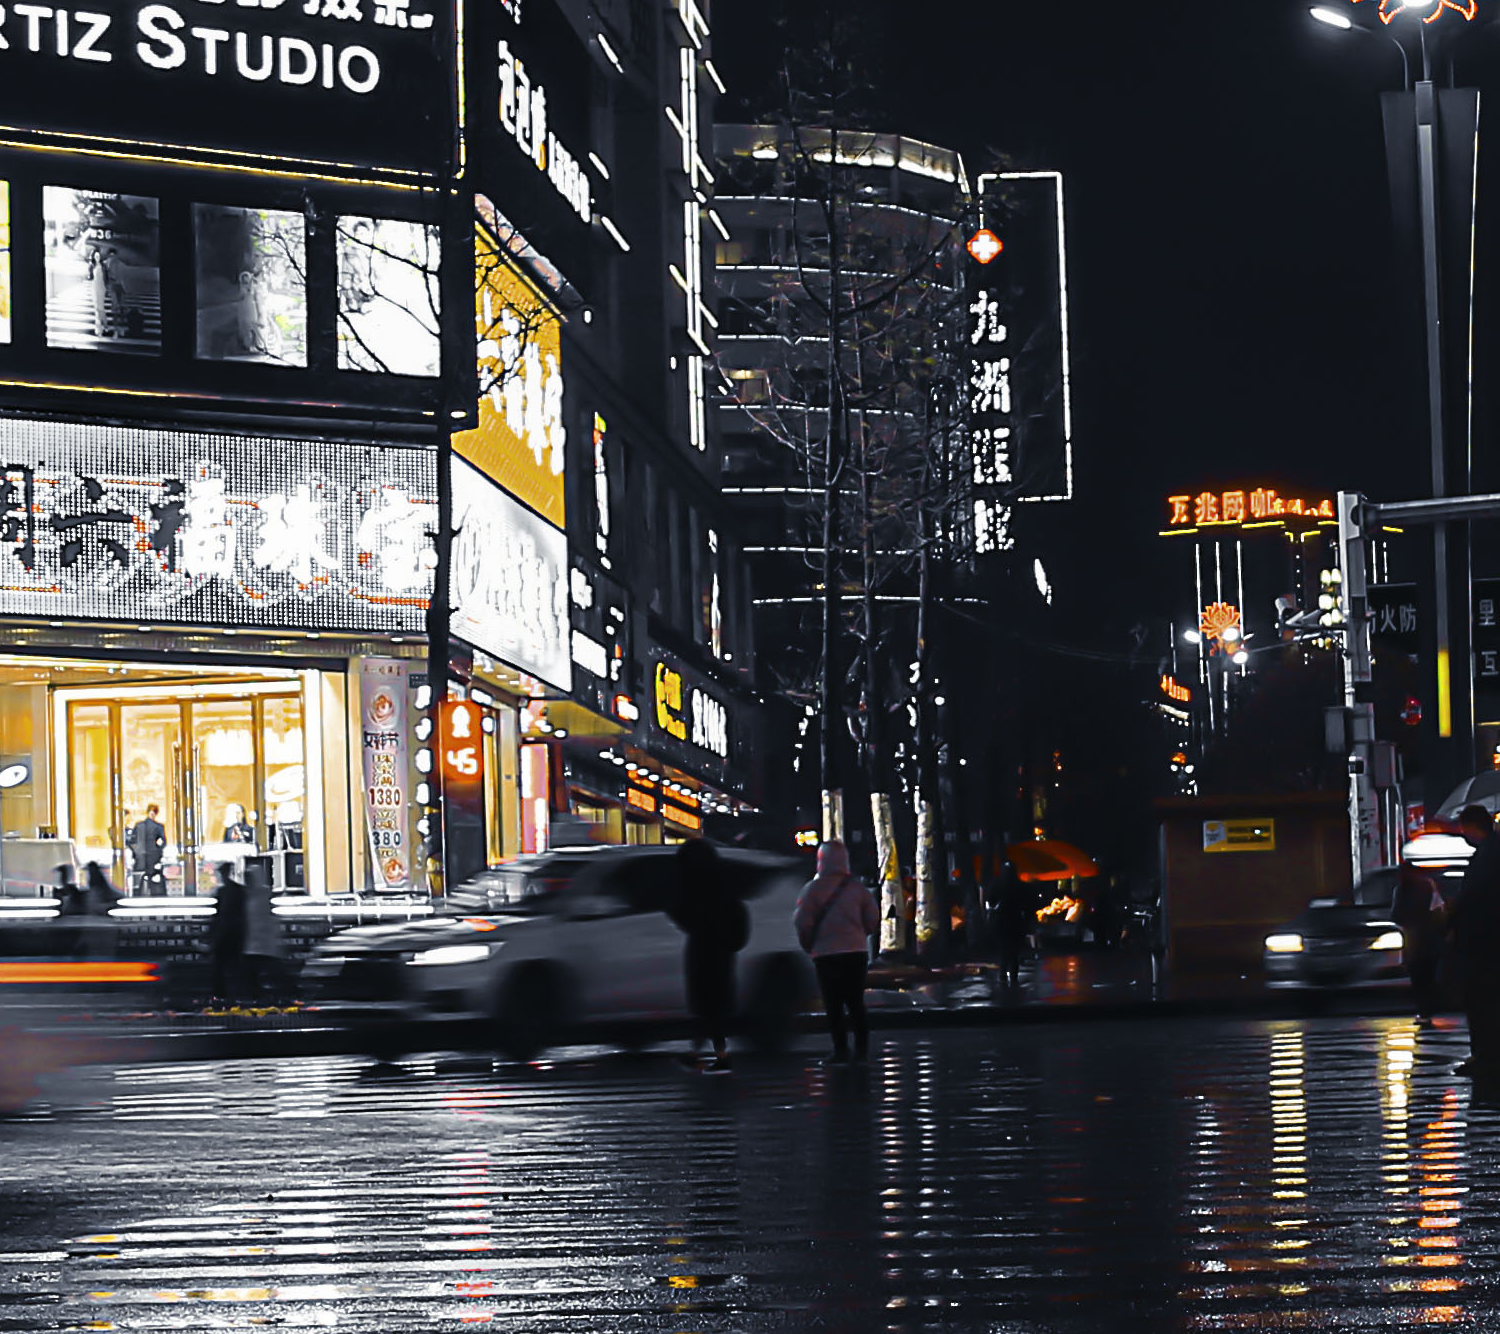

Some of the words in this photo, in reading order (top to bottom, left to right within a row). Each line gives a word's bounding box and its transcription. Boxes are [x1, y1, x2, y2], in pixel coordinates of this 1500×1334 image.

[1168, 488, 1277, 524] 万兆网咖
[369, 787, 401, 806] 1380
[372, 831, 401, 846] 380
